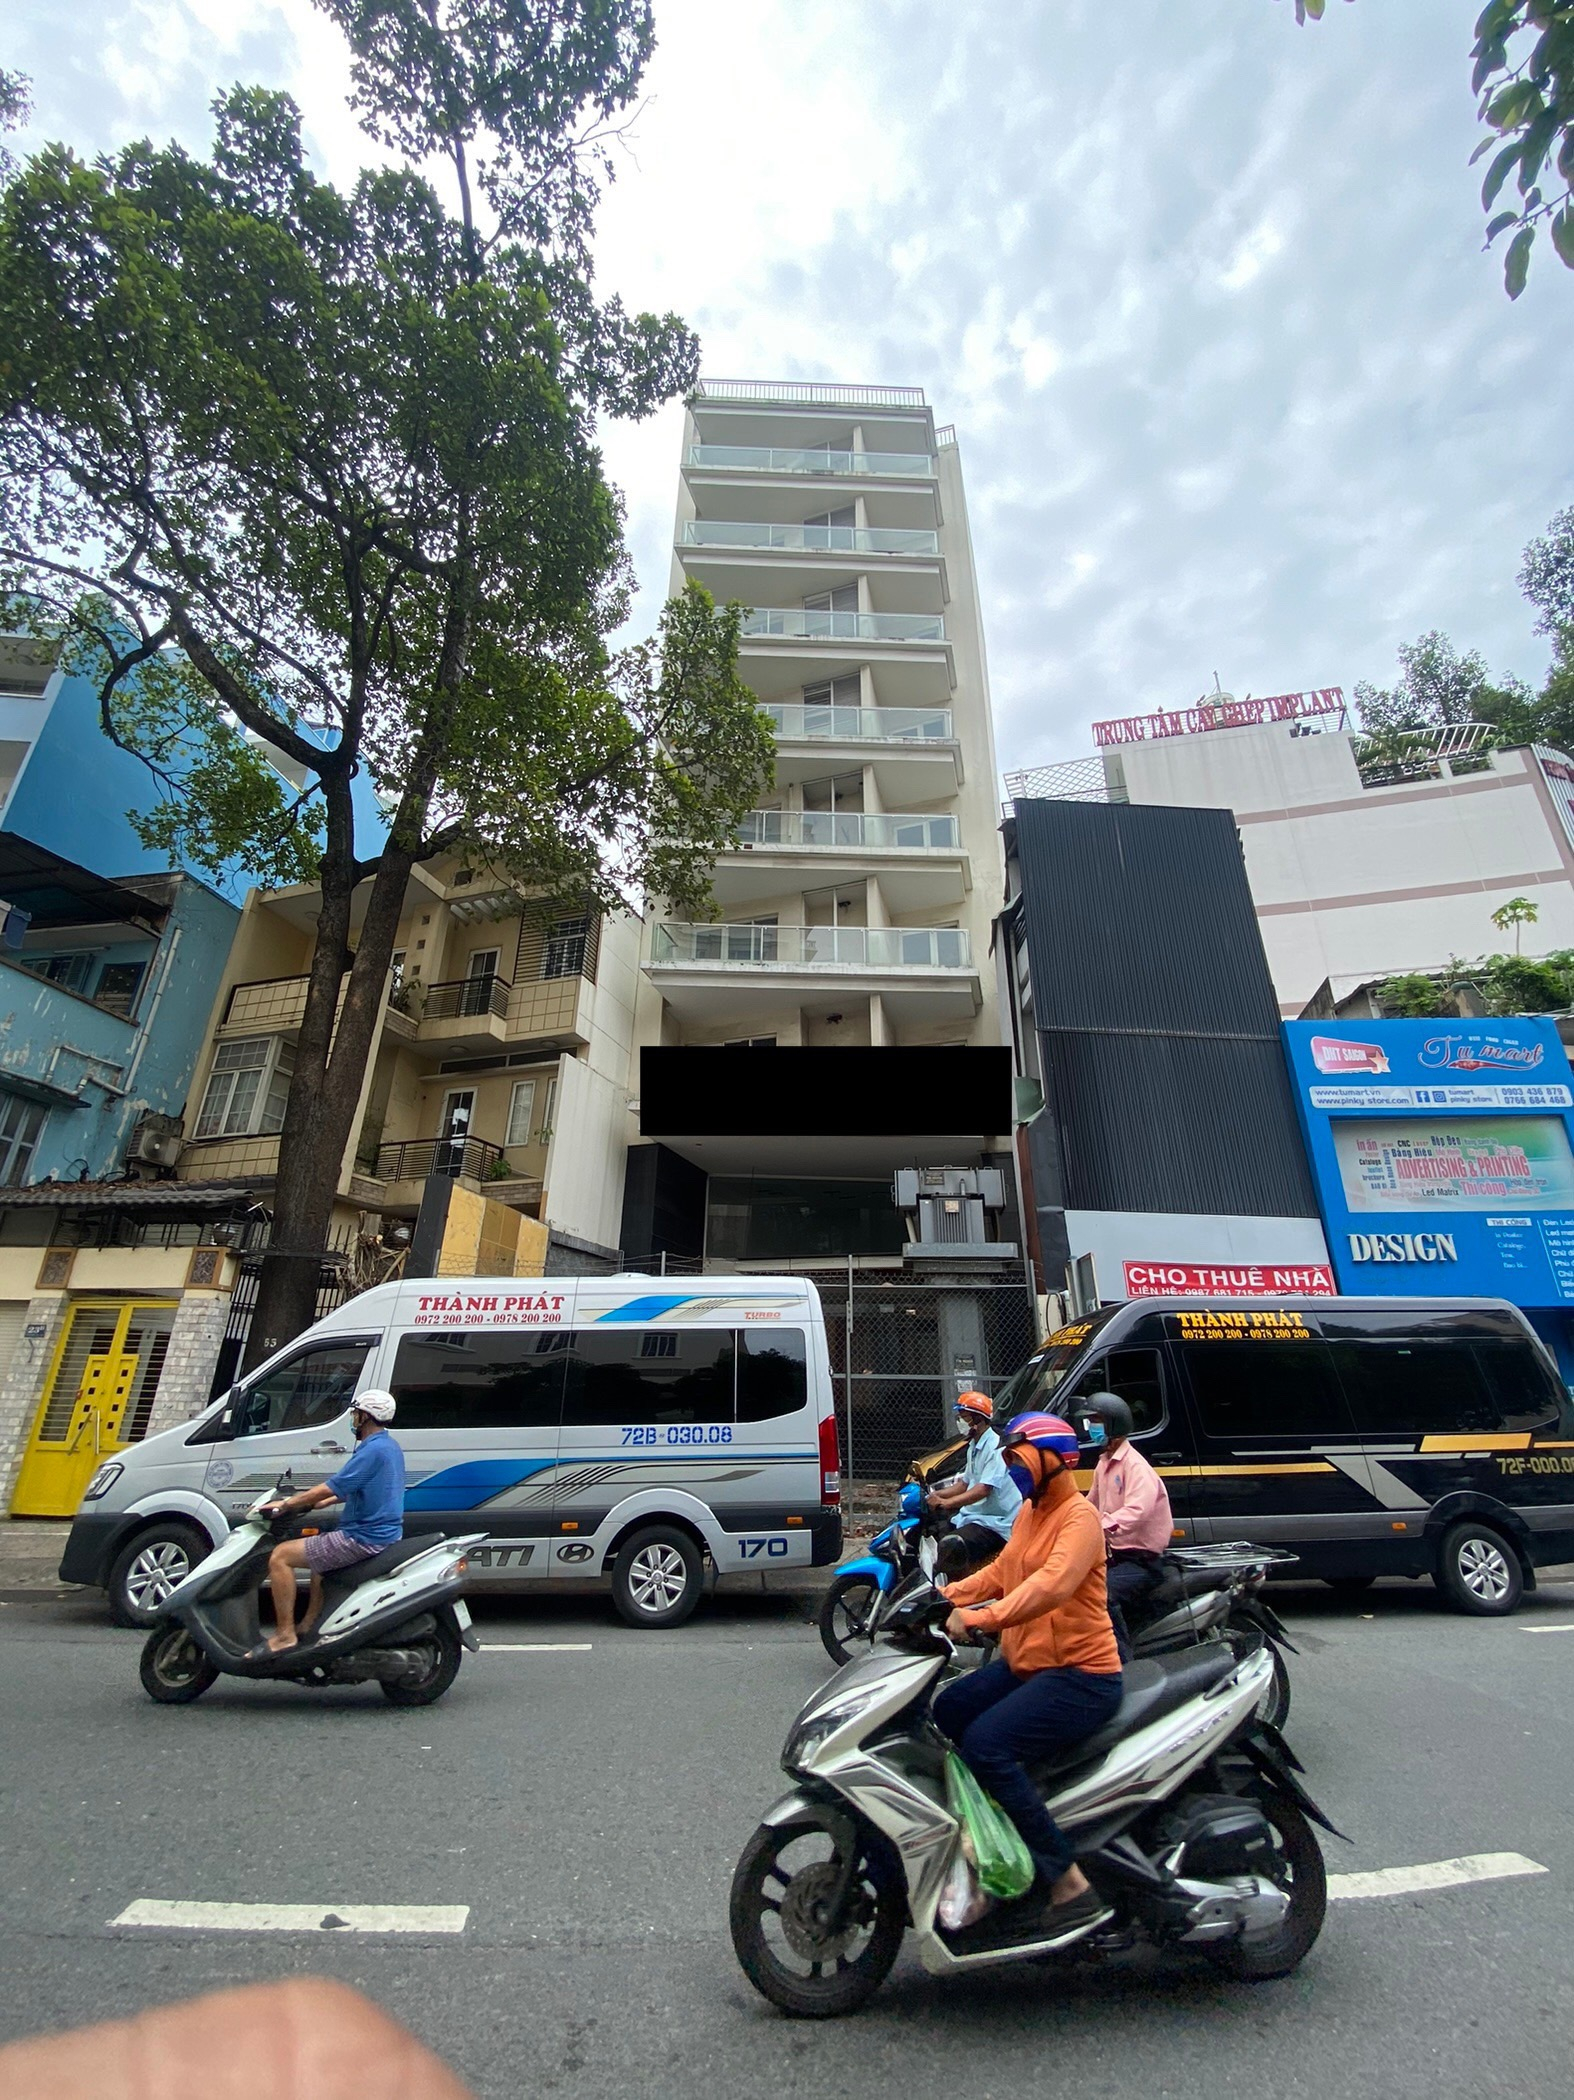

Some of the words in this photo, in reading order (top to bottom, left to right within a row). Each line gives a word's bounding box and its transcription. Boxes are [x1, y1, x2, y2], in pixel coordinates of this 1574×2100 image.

[1091, 714, 1146, 746] TRUNG
[1267, 686, 1347, 721] IMPLANT
[1501, 1087, 1524, 1096] 0903
[1546, 1087, 1563, 1096] 879
[1397, 1139, 1411, 1147] CNC
[1395, 1156, 1468, 1179] ADVERTISING
[1468, 1160, 1478, 1178] &
[1476, 1155, 1531, 1177] PRINTING
[1421, 1188, 1435, 1197] Led
[1347, 1233, 1458, 1262] DESIGN
[1129, 1267, 1187, 1285] CHO
[1193, 1267, 1265, 1287] THUÊ
[1273, 1266, 1330, 1287] NHÀ
[419, 1291, 499, 1311] THÀNH
[503, 1290, 565, 1311] PHÁT
[414, 1315, 440, 1325] 0972
[442, 1315, 462, 1325] 200
[464, 1314, 484, 1324] 200
[493, 1314, 518, 1324] 0978
[521, 1313, 540, 1323] 200
[542, 1313, 562, 1323] 200
[744, 1311, 781, 1320] TURBO
[1176, 1308, 1250, 1328] THÀNH
[1250, 1308, 1304, 1327] PHÁT
[1181, 1329, 1206, 1340] 0972
[1206, 1329, 1224, 1340] 200
[1226, 1329, 1243, 1340] 200
[1250, 1329, 1272, 1340] 0978
[1274, 1329, 1291, 1340] 200
[1292, 1329, 1310, 1340] 200
[738, 1537, 787, 1559] 170
